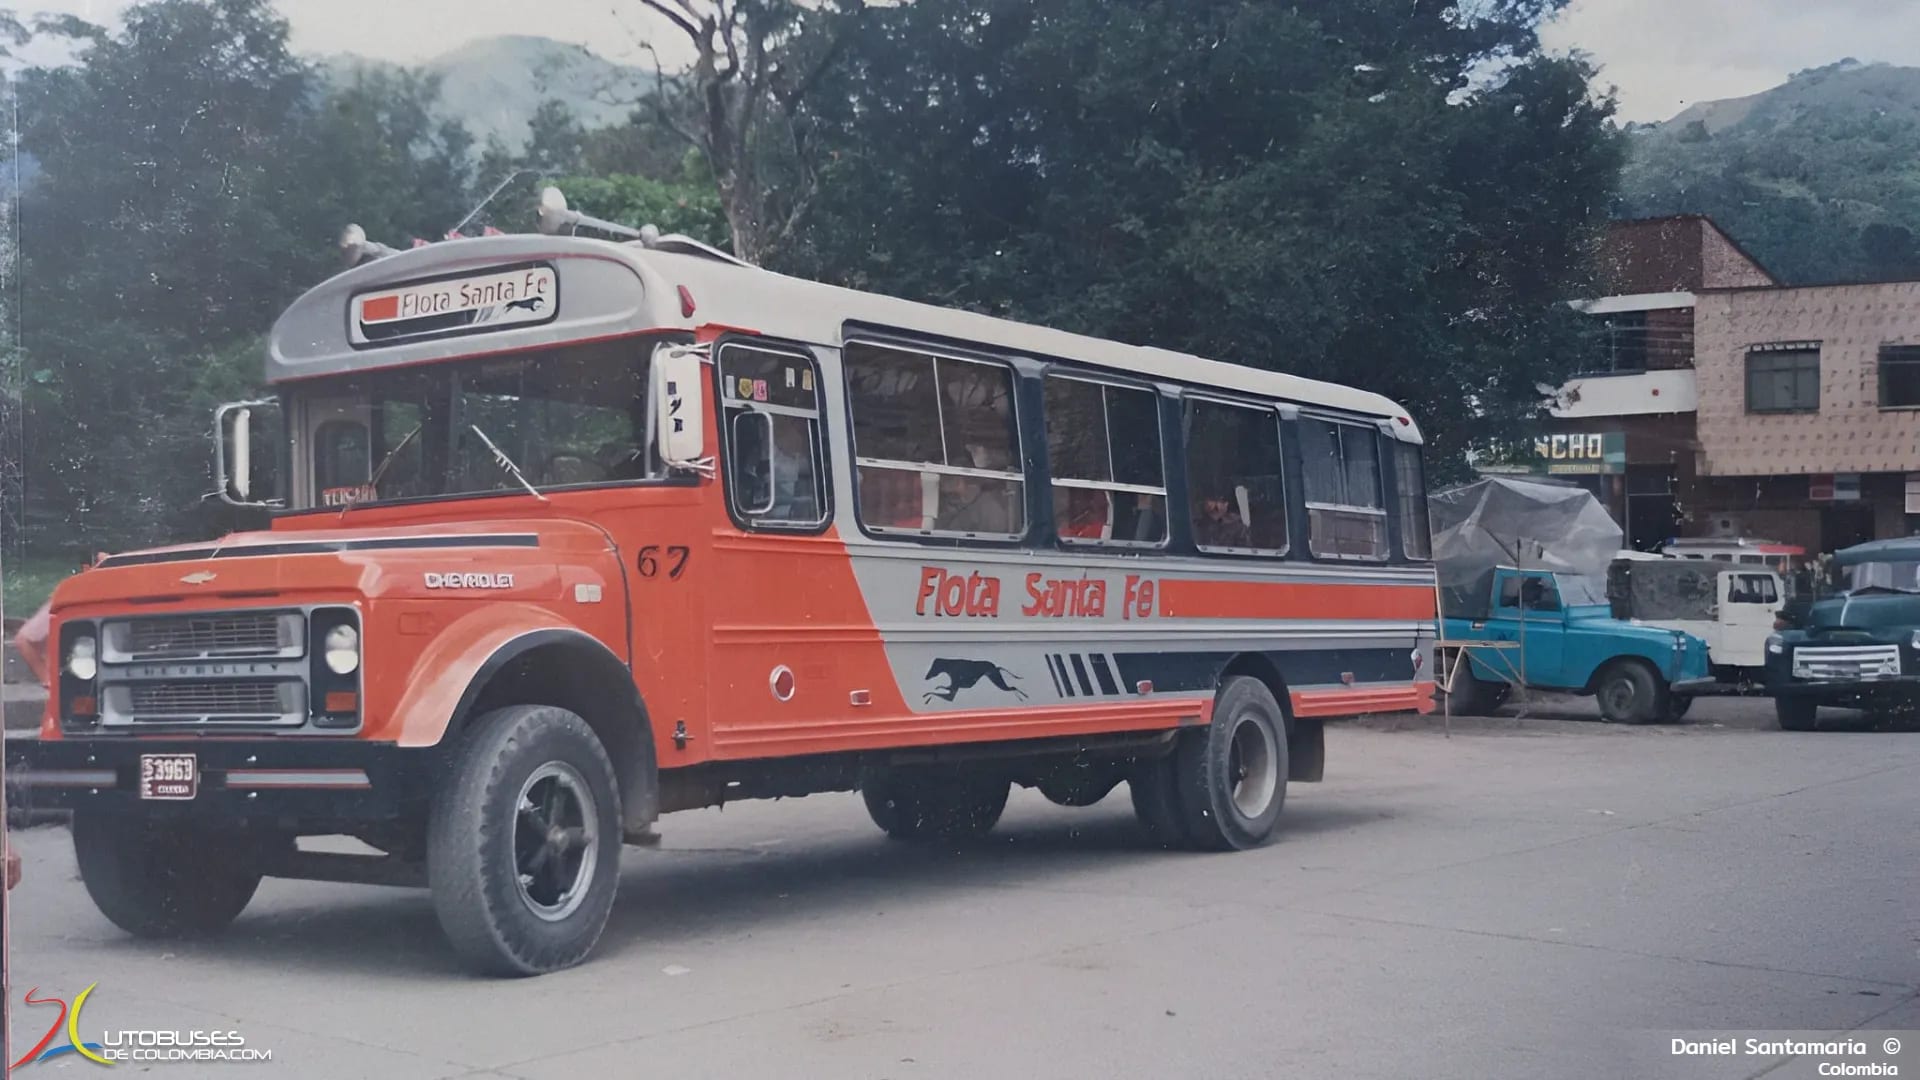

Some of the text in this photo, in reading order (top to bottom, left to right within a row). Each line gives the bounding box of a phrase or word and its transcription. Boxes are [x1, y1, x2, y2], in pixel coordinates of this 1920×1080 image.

[402, 271, 549, 317] Flota Santa Fe
[1533, 432, 1603, 460] NCHO
[637, 545, 692, 579] 67
[424, 572, 515, 590] CHEVROLET
[916, 565, 1154, 621] Flota Santa Fe
